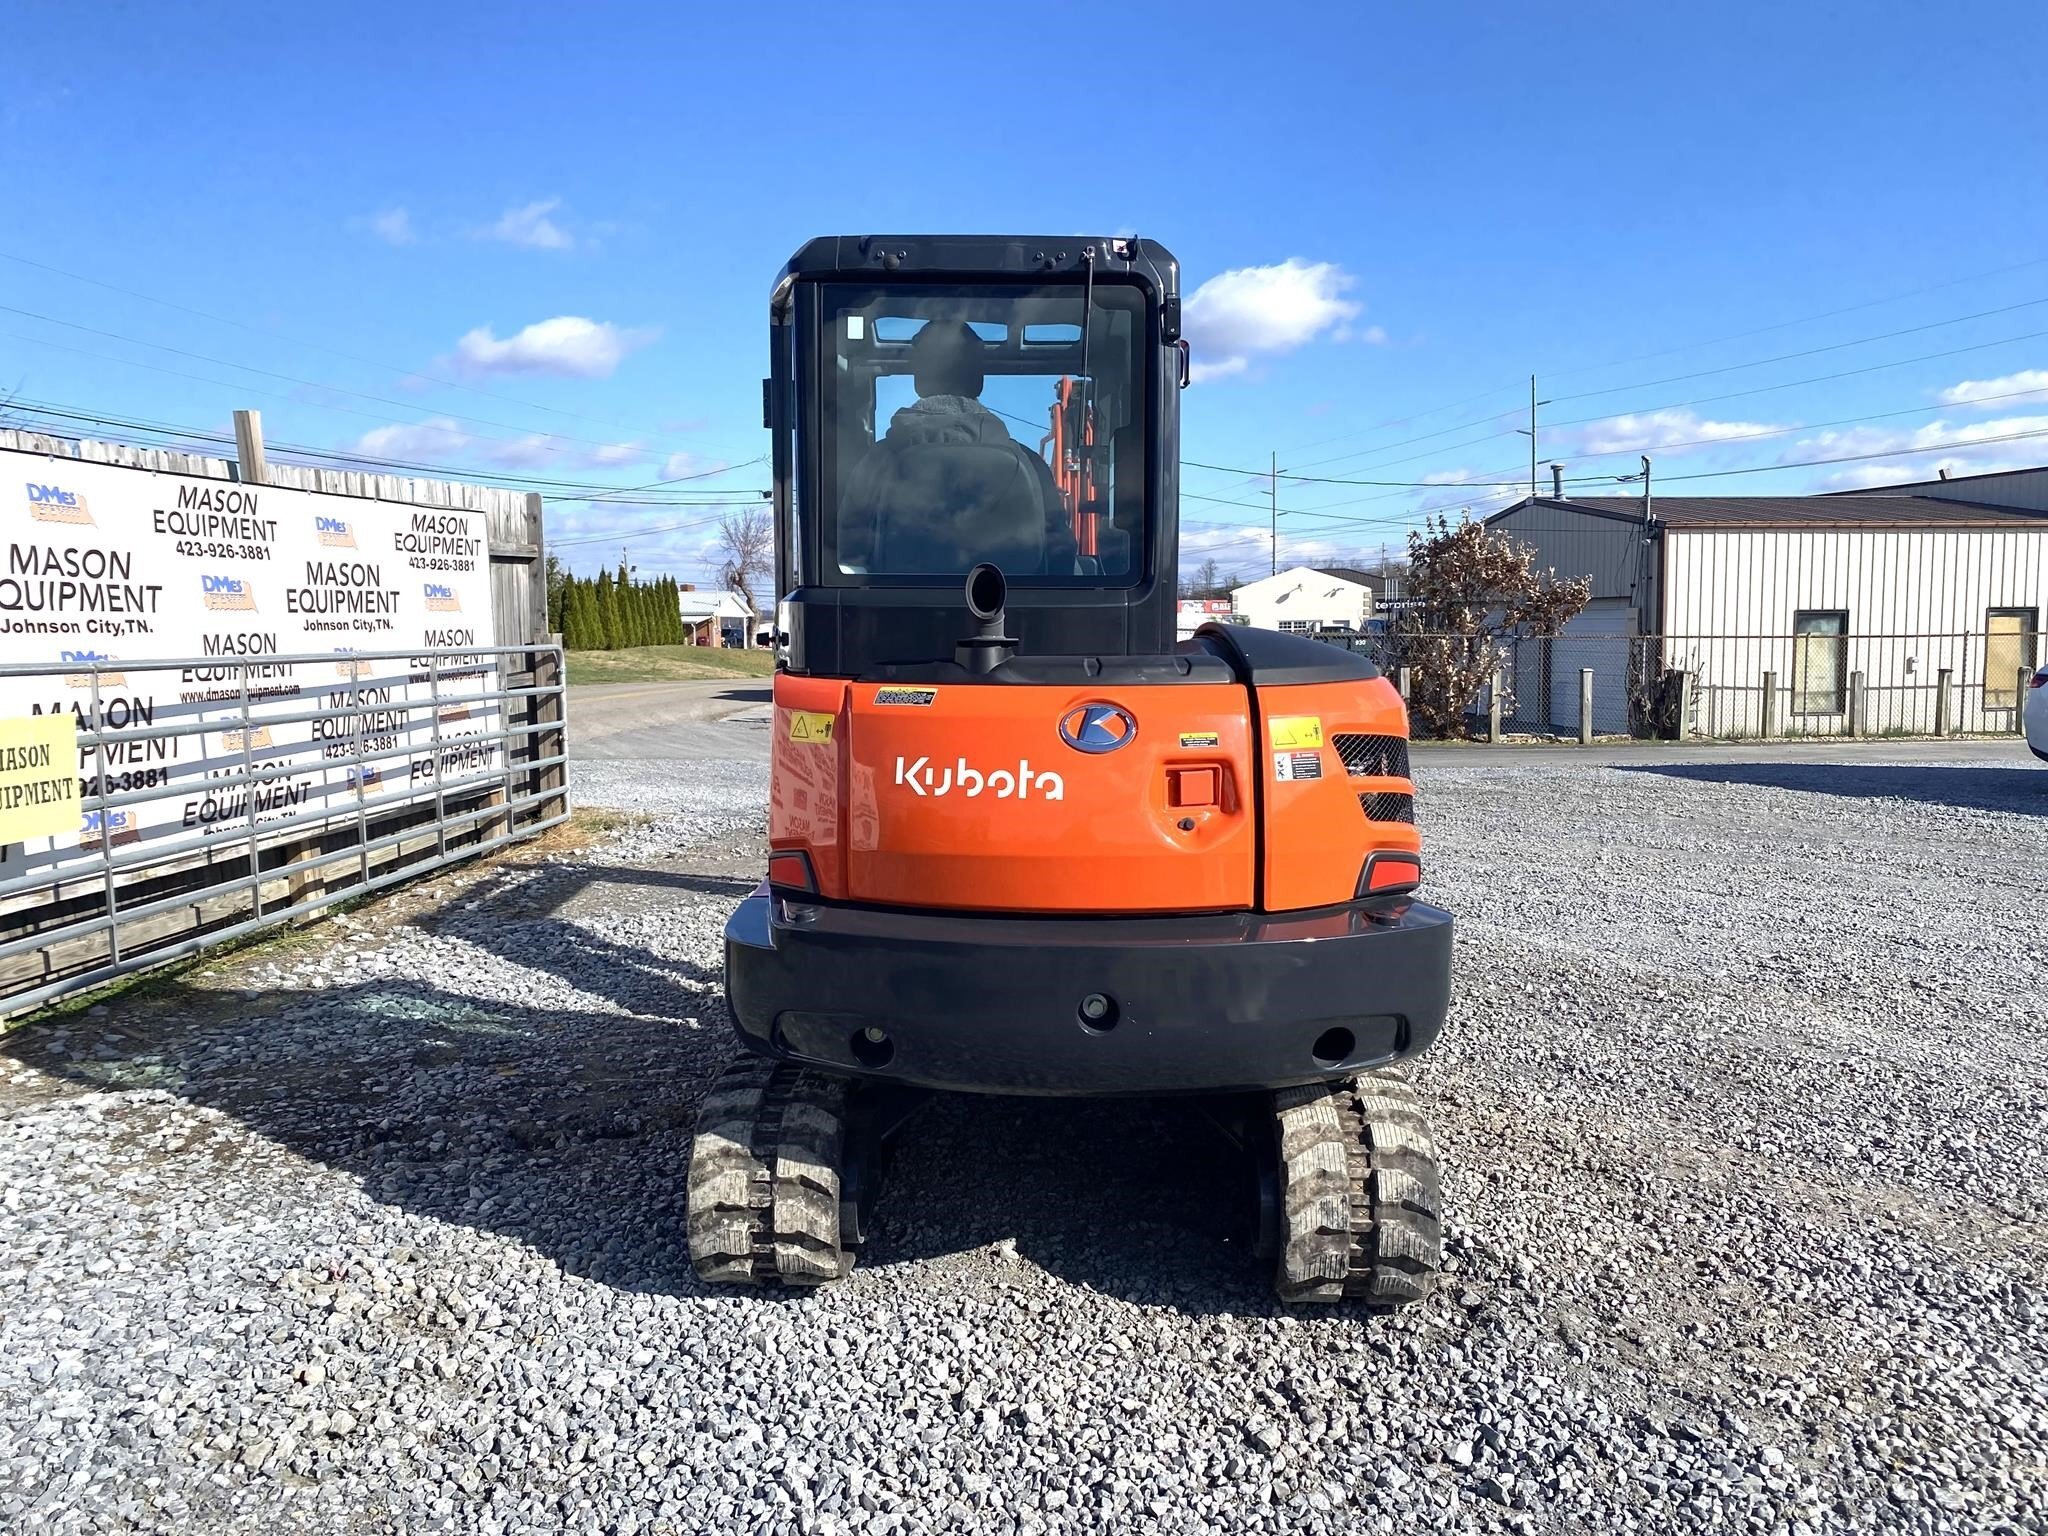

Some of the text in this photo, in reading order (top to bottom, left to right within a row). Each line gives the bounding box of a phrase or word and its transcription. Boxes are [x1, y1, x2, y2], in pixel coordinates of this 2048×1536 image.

[178, 485, 258, 515] MASON
[153, 510, 277, 542] EQUIPMENT
[411, 513, 468, 535] MASON
[176, 541, 271, 560] 423-926-3881
[394, 532, 481, 557] EQUIPMENT
[10, 543, 131, 580] MASON
[306, 561, 380, 587] MASON
[409, 557, 475, 572] 423-926-3881
[0, 578, 163, 614] QUIPMENT
[286, 588, 400, 614] EQUIPMENT
[0, 618, 81, 634] Johnson
[303, 618, 349, 632] Johnson
[424, 628, 474, 648] MASON
[203, 632, 277, 657] MASON
[410, 654, 484, 668] EQIPMENT
[179, 683, 301, 704] www.dmasonquipment.com
[32, 697, 153, 732] AON
[312, 709, 407, 742] EQUIMENT
[0, 743, 50, 772] ASON
[326, 735, 398, 759] 423-96-3881
[79, 767, 168, 798] 926-3881
[895, 756, 1064, 800] Kubota
[0, 777, 73, 810] IPMENT
